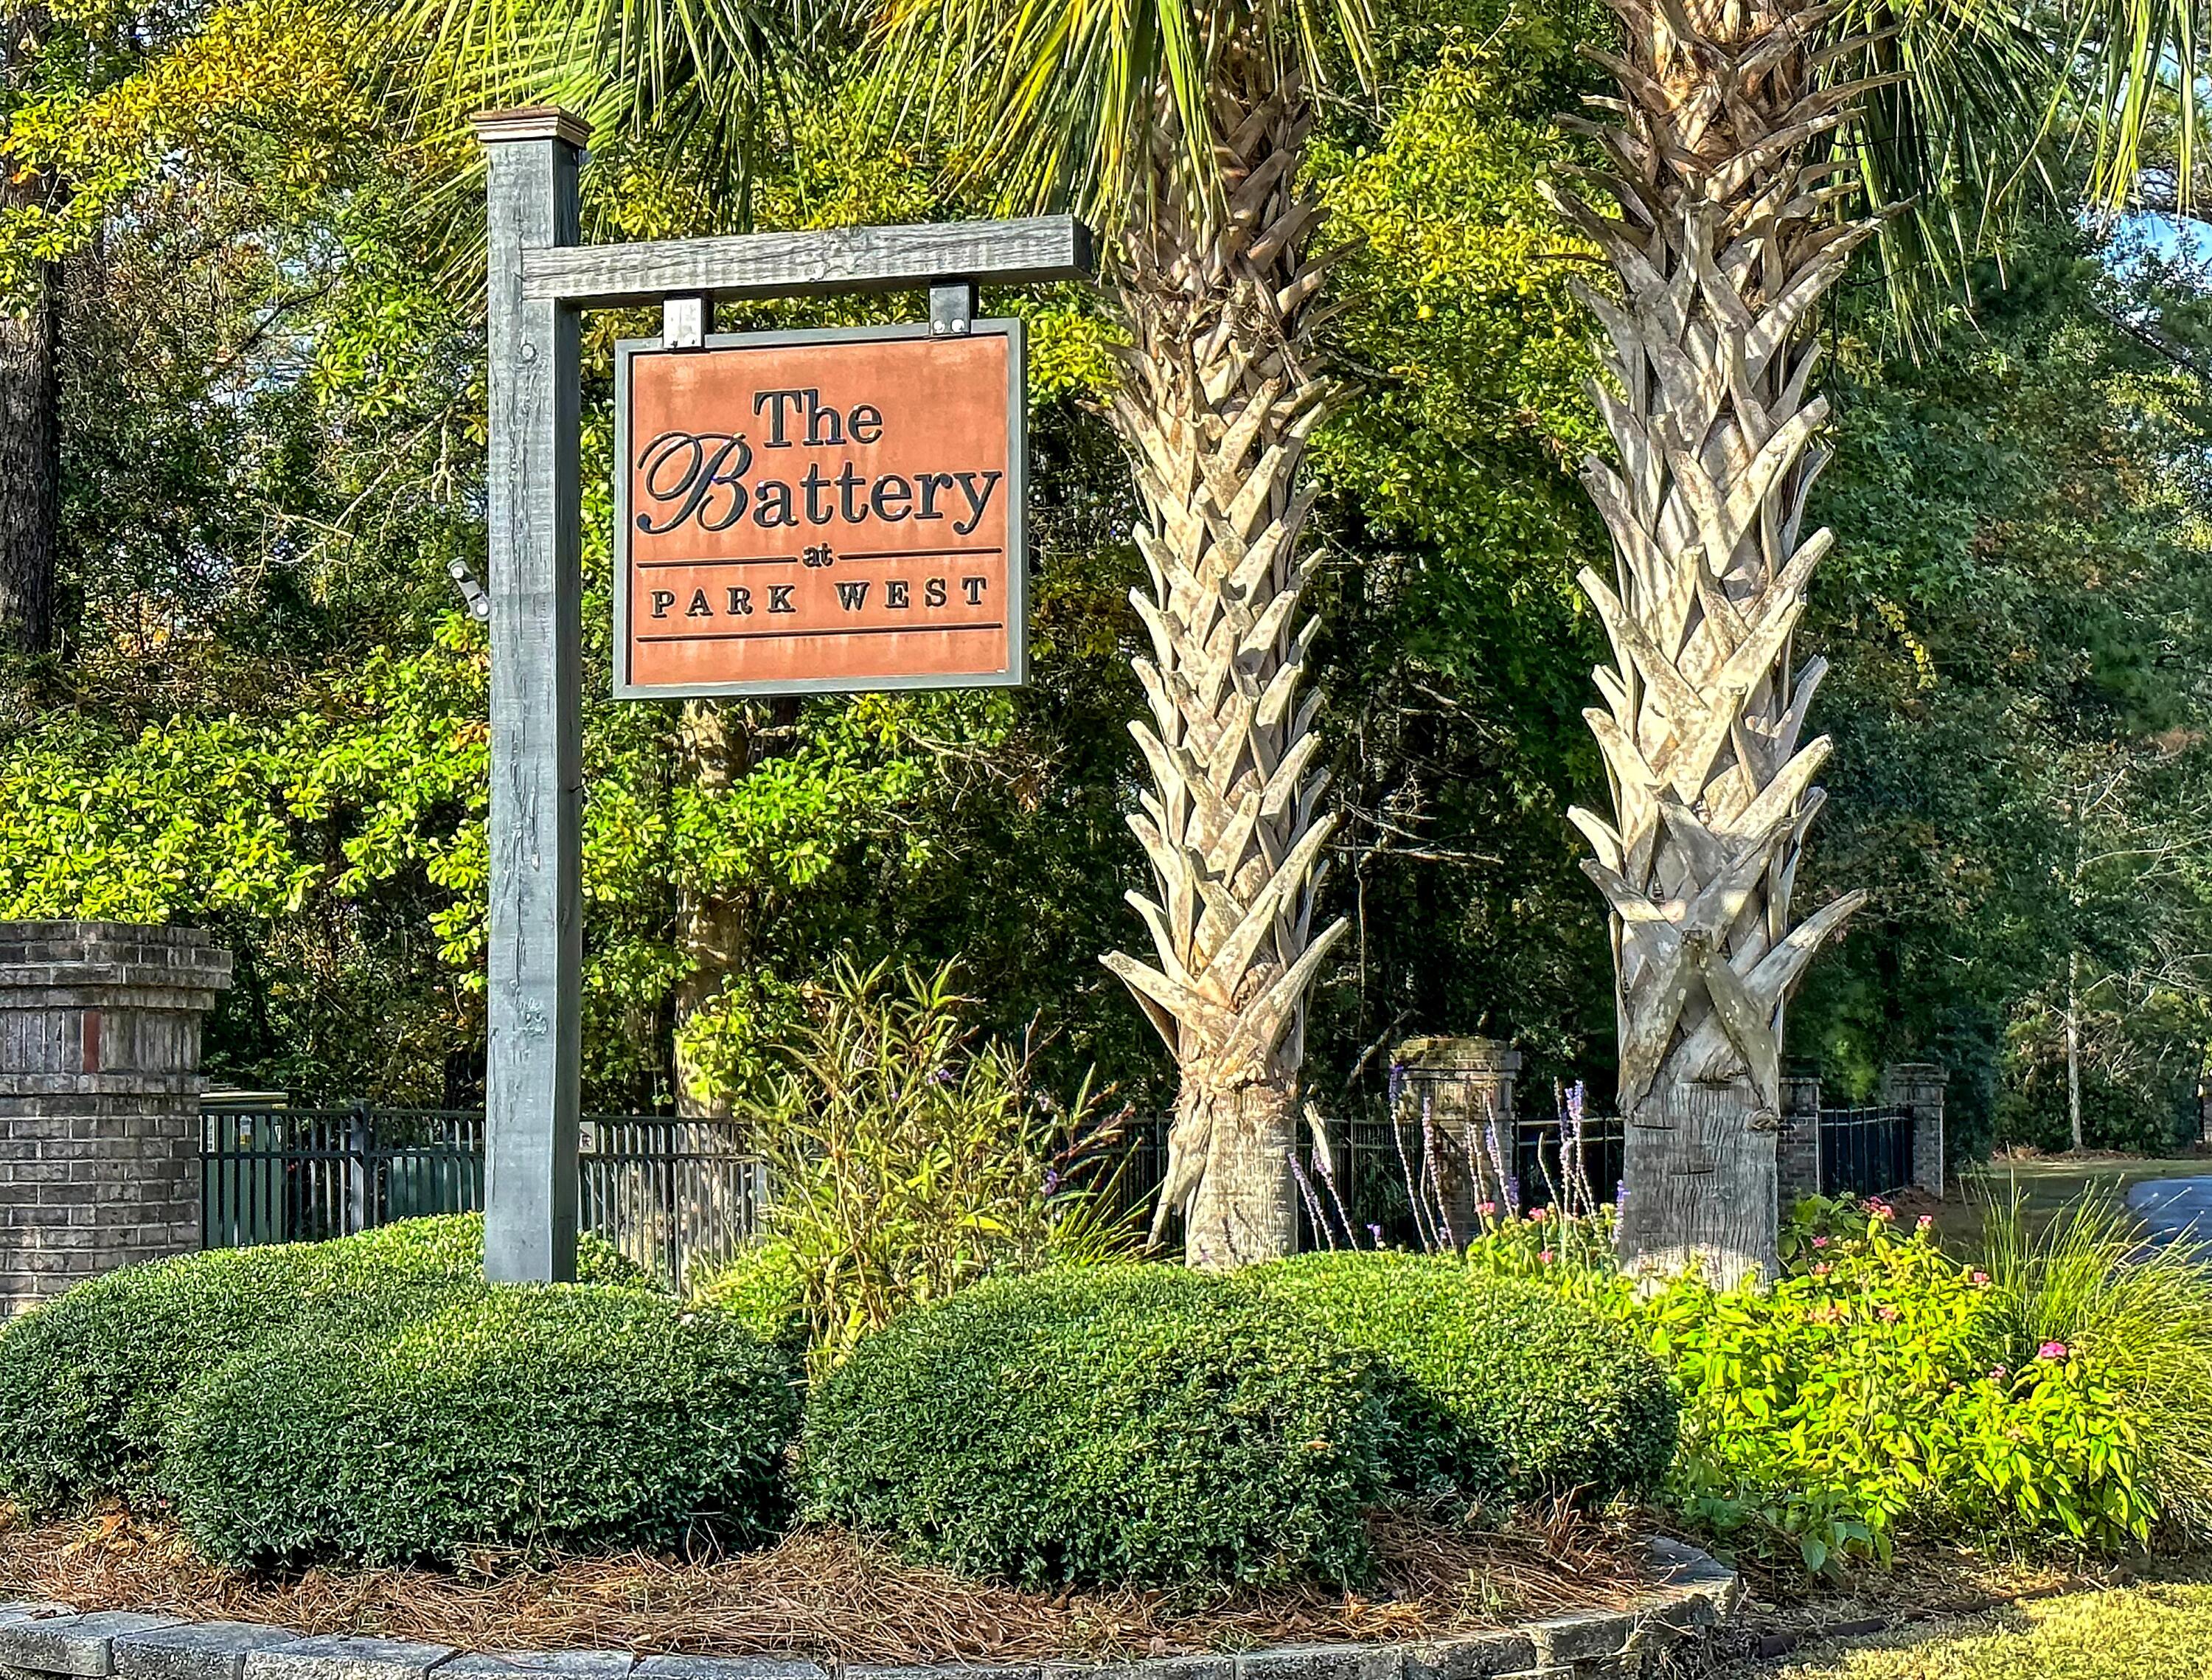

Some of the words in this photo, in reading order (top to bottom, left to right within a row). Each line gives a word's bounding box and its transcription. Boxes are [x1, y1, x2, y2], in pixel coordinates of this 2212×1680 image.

[754, 389, 883, 448] The
[636, 431, 1002, 535] Battery
[802, 543, 834, 568] at
[650, 585, 797, 619] PARK
[835, 577, 987, 611] WEST
